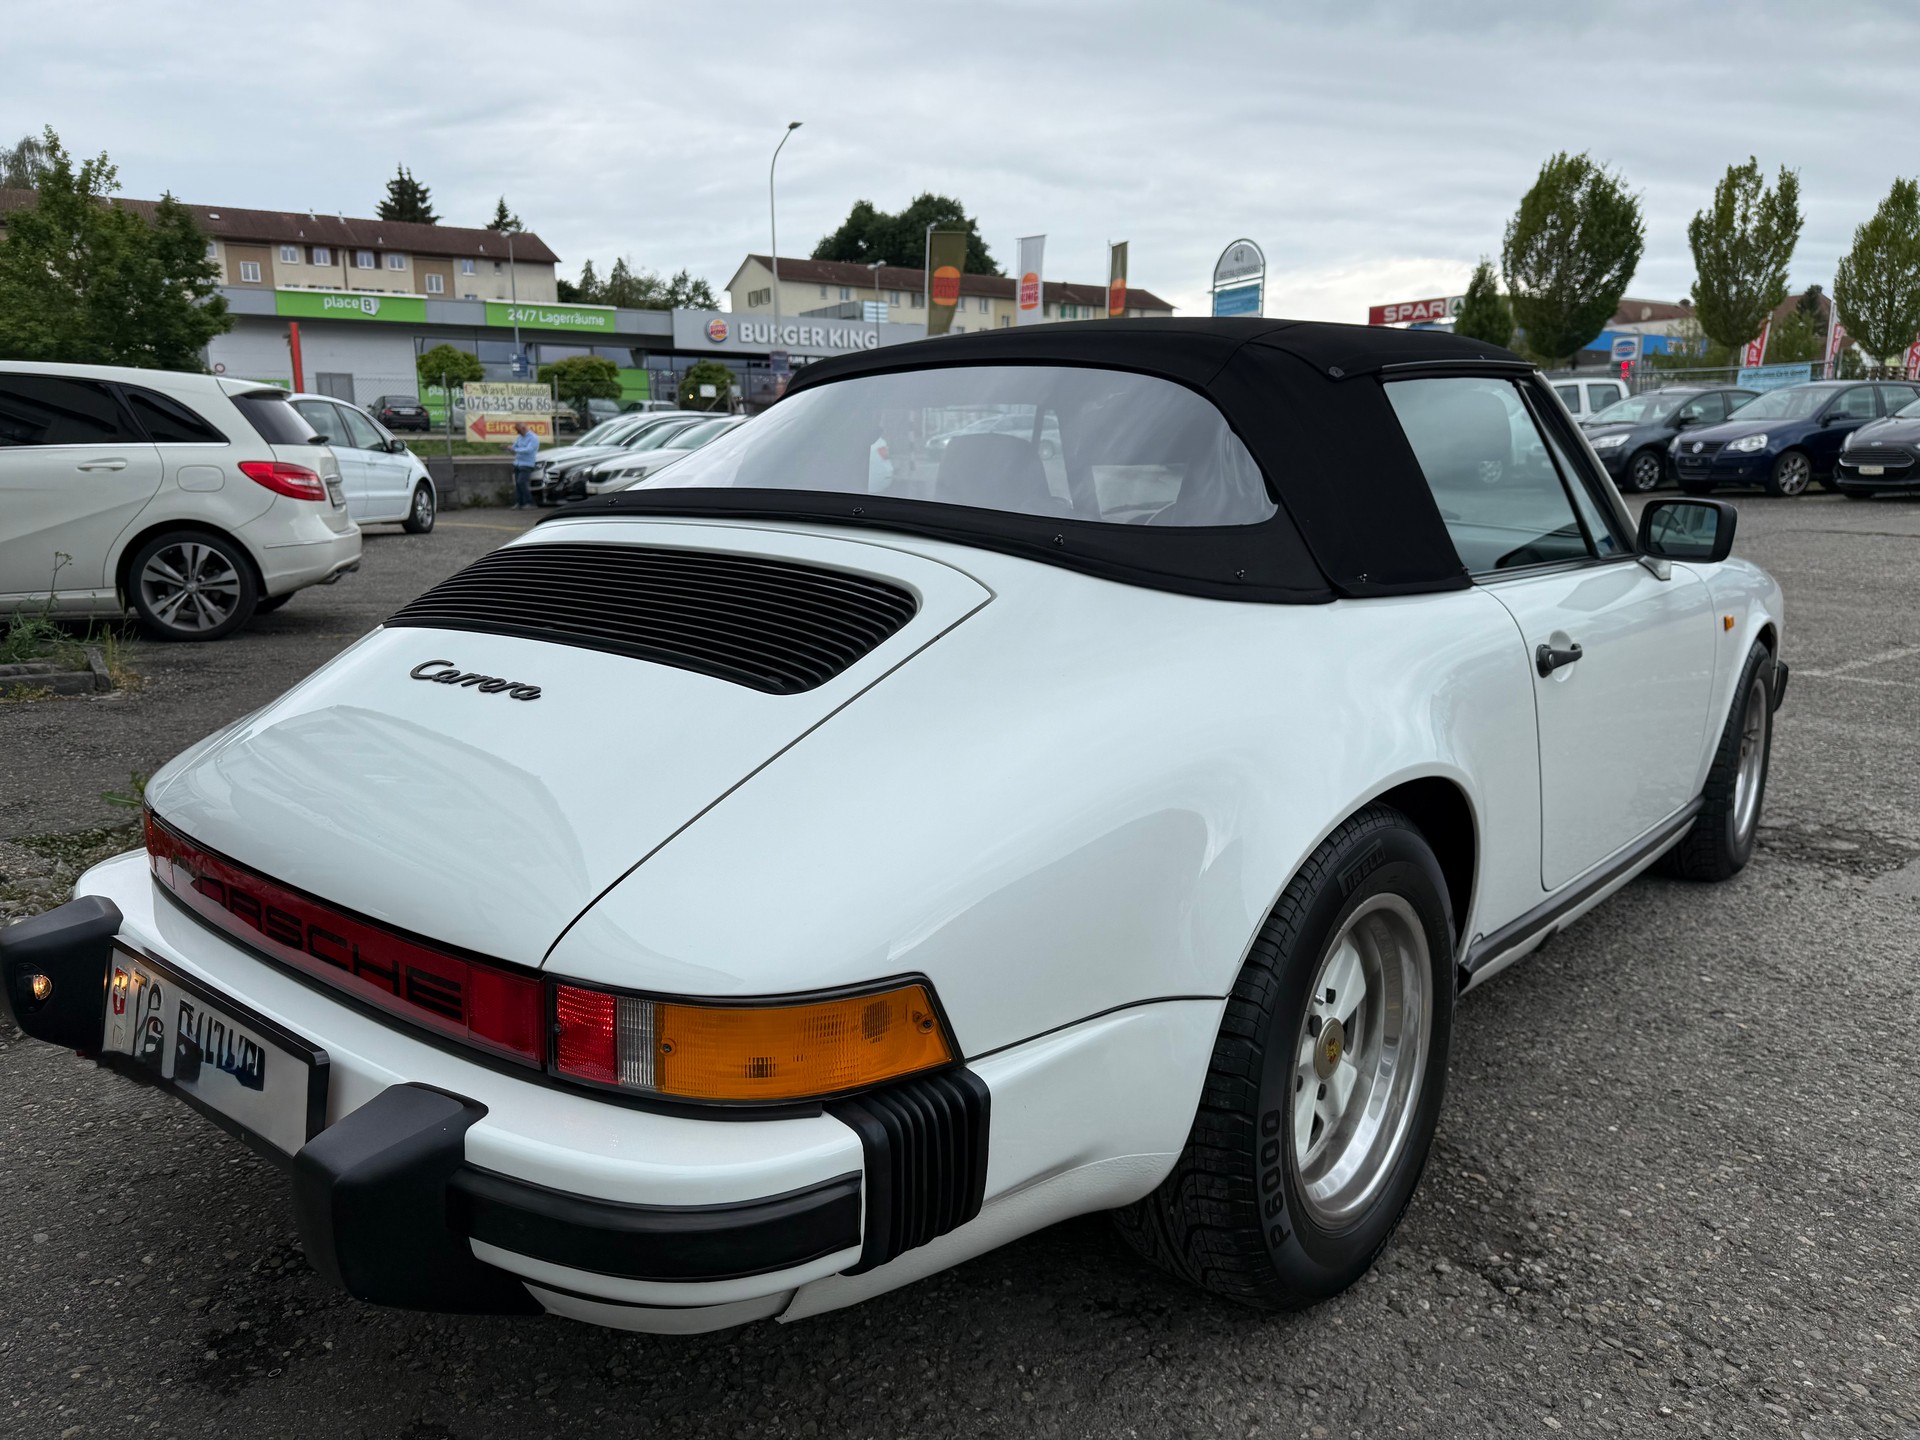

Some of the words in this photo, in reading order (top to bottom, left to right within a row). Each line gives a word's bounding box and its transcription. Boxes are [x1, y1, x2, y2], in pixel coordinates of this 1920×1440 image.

[324, 295, 360, 309] place
[1383, 301, 1445, 322] SPAR
[507, 308, 536, 321] 24/7
[539, 311, 605, 326] Lagerräume
[739, 323, 825, 347] BURGER
[829, 328, 878, 349] KING
[467, 396, 515, 411] 076-345
[518, 397, 534, 411] 66
[536, 398, 552, 411] 86
[486, 422, 546, 435] Eingng
[410, 659, 541, 701] Carrera
[1261, 1109, 1284, 1220] 6000
[1270, 1223, 1291, 1249] P
